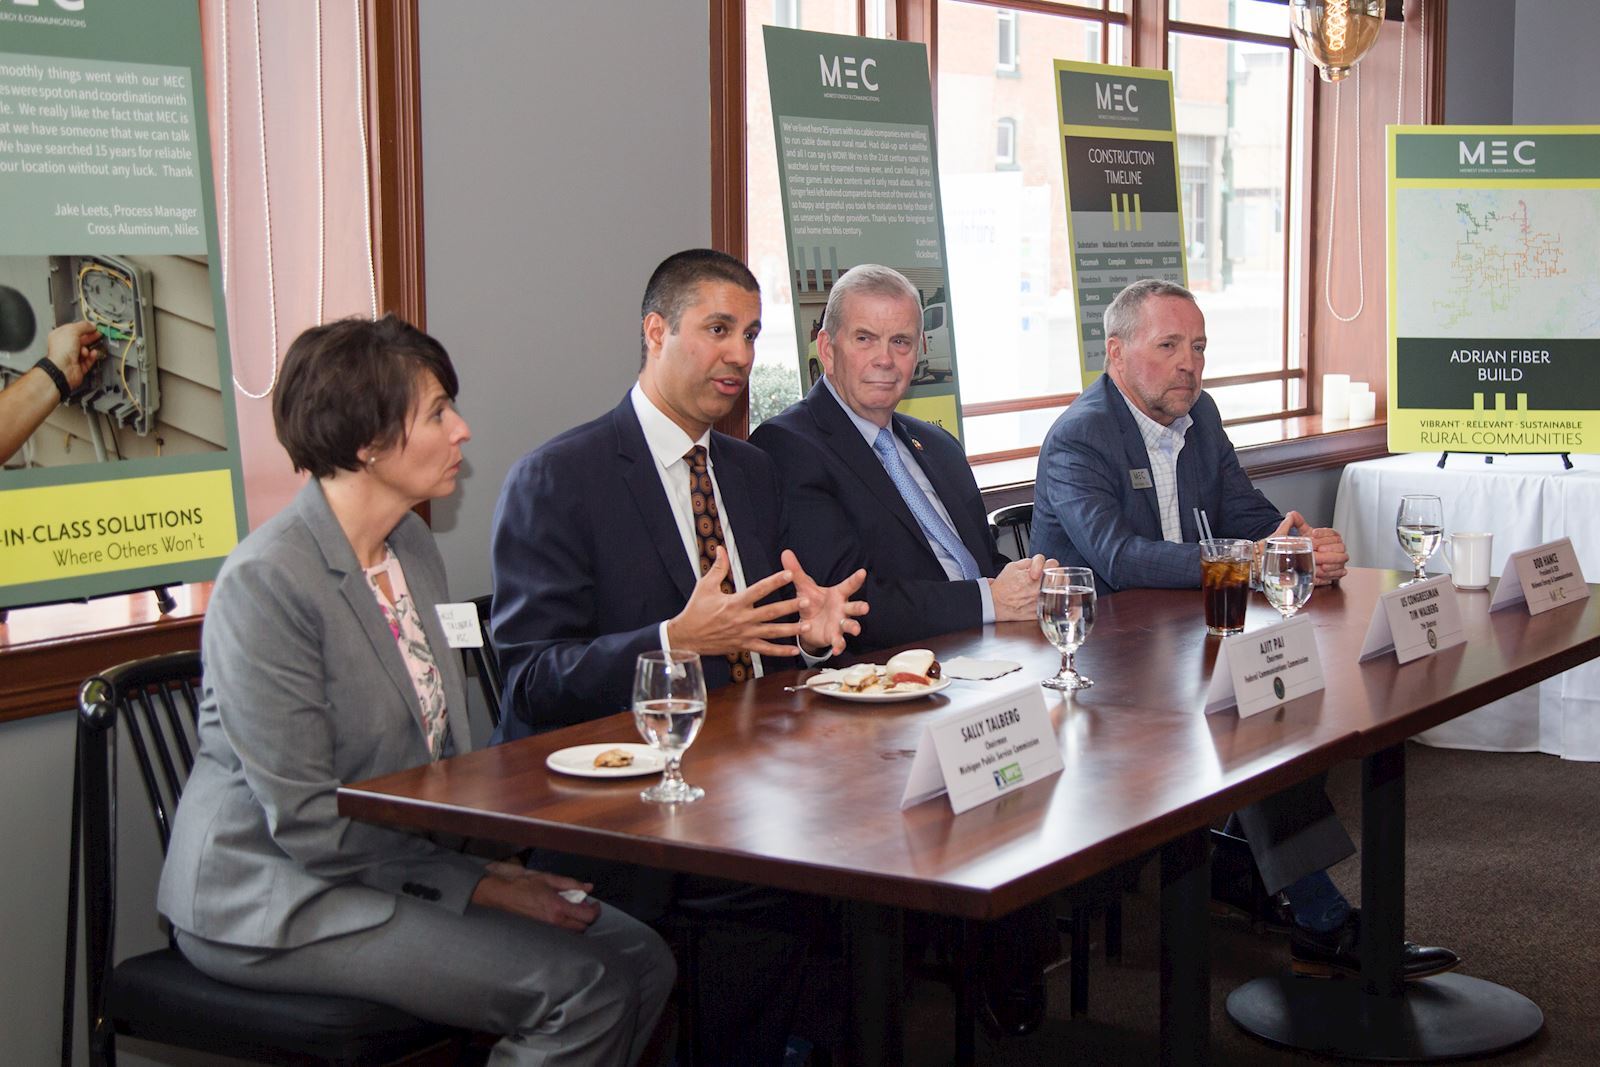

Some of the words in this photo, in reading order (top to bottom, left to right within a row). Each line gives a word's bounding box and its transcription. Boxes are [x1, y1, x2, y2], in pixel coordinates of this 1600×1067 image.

[24, 14, 87, 28] COMMUNICATIONS
[0, 64, 44, 80] moothly
[48, 66, 81, 84] things
[85, 71, 112, 83] went
[116, 71, 138, 85] with
[142, 75, 160, 86] our
[163, 75, 185, 89] MEC
[819, 54, 879, 91] MEC
[0, 84, 10, 95] es
[11, 85, 38, 97] were
[39, 87, 63, 101] spot
[64, 88, 78, 99] on
[79, 87, 99, 100] and
[100, 90, 164, 105] coordination
[165, 92, 187, 106] with
[1095, 82, 1138, 112] MEC
[19, 102, 36, 116] We
[39, 103, 68, 120] really
[71, 104, 90, 119] like
[92, 106, 110, 120] the
[112, 107, 130, 121] fact
[133, 109, 154, 122] that
[156, 111, 179, 124] MEC
[180, 112, 189, 124] is
[0, 121, 10, 133] at
[13, 123, 29, 135] we
[31, 121, 58, 136] have
[60, 126, 109, 138] someone
[111, 126, 132, 139] that
[134, 129, 149, 140] we
[152, 131, 169, 141] can
[171, 129, 190, 142] talk
[0, 140, 14, 153] We
[16, 140, 43, 154] have
[44, 142, 93, 156] searched
[95, 144, 108, 157] 15
[109, 147, 136, 160] years
[138, 145, 152, 159] for
[154, 146, 192, 160] reliable
[1088, 148, 1155, 165] CONSTRUCTION
[1459, 140, 1536, 166] MEC
[0, 161, 19, 172] our
[21, 159, 66, 174] location
[68, 161, 109, 175] without
[112, 165, 131, 178] any
[133, 163, 158, 177] luck.
[162, 164, 194, 178] Thank
[1104, 170, 1142, 185] TIMELINE
[55, 203, 79, 217] Jake
[81, 204, 112, 219] Leets,
[114, 204, 153, 217] Process
[155, 205, 198, 221] Manager
[87, 222, 116, 235] Cross
[118, 222, 173, 238] Aluminum,
[174, 223, 200, 236] Niles
[1134, 258, 1153, 266] Underway
[1450, 350, 1506, 364] ADRIAN
[1510, 350, 1551, 364] FIBER
[1478, 368, 1523, 381] BUILD
[1420, 420, 1460, 428] VIBRANT
[1466, 421, 1514, 429] RELEVANT
[1520, 421, 1583, 429] SUSTAINABLE
[1421, 431, 1467, 444] RURAL
[1471, 431, 1583, 445] COMMUNITIES
[97, 508, 203, 536] SOLUTIONS
[53, 548, 103, 567] Where
[107, 542, 158, 561] Others
[161, 532, 205, 553] Won't
[1407, 588, 1439, 605] CONGRESSMAN
[1409, 609, 1419, 620] TIM
[1419, 603, 1439, 617] WALBERG
[1260, 640, 1272, 654] AJIT
[1273, 635, 1285, 650] PAI
[1266, 653, 1284, 663] Chairman
[1287, 656, 1309, 668] Commission
[961, 721, 985, 743] SALLY
[985, 708, 1021, 732] TALBERG
[985, 737, 1007, 750] Chairman
[959, 762, 981, 775] Michigan
[981, 755, 996, 766] Public
[995, 749, 1013, 760] Service
[1013, 738, 1040, 753] Commission
